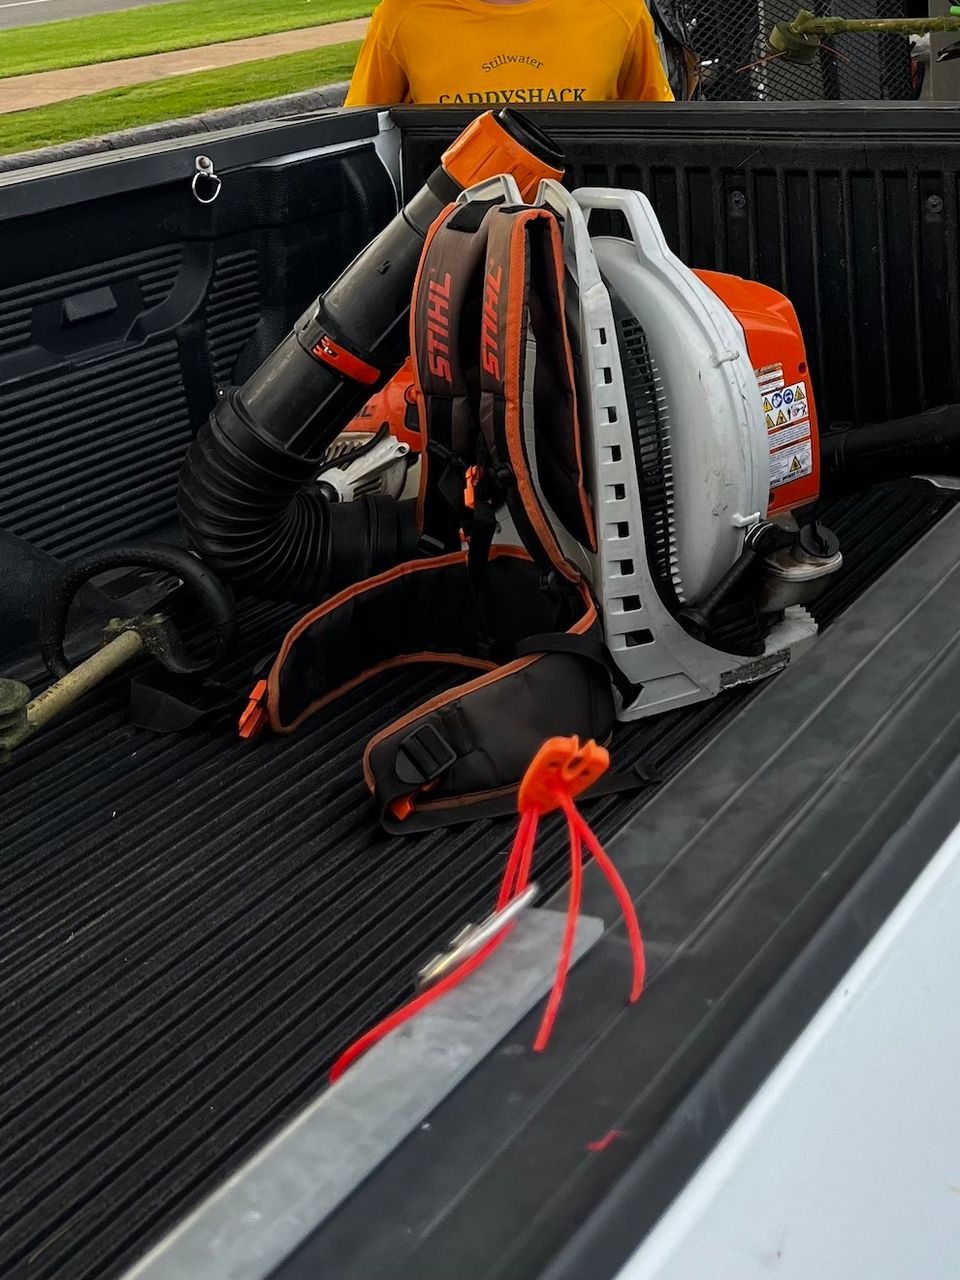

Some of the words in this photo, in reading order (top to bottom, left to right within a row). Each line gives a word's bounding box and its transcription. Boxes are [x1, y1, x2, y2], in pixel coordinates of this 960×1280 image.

[439, 88, 587, 104] CADDYSHACK
[481, 53, 544, 73] Stillwater
[427, 272, 452, 384] STIHL
[481, 265, 503, 382] STIHL
